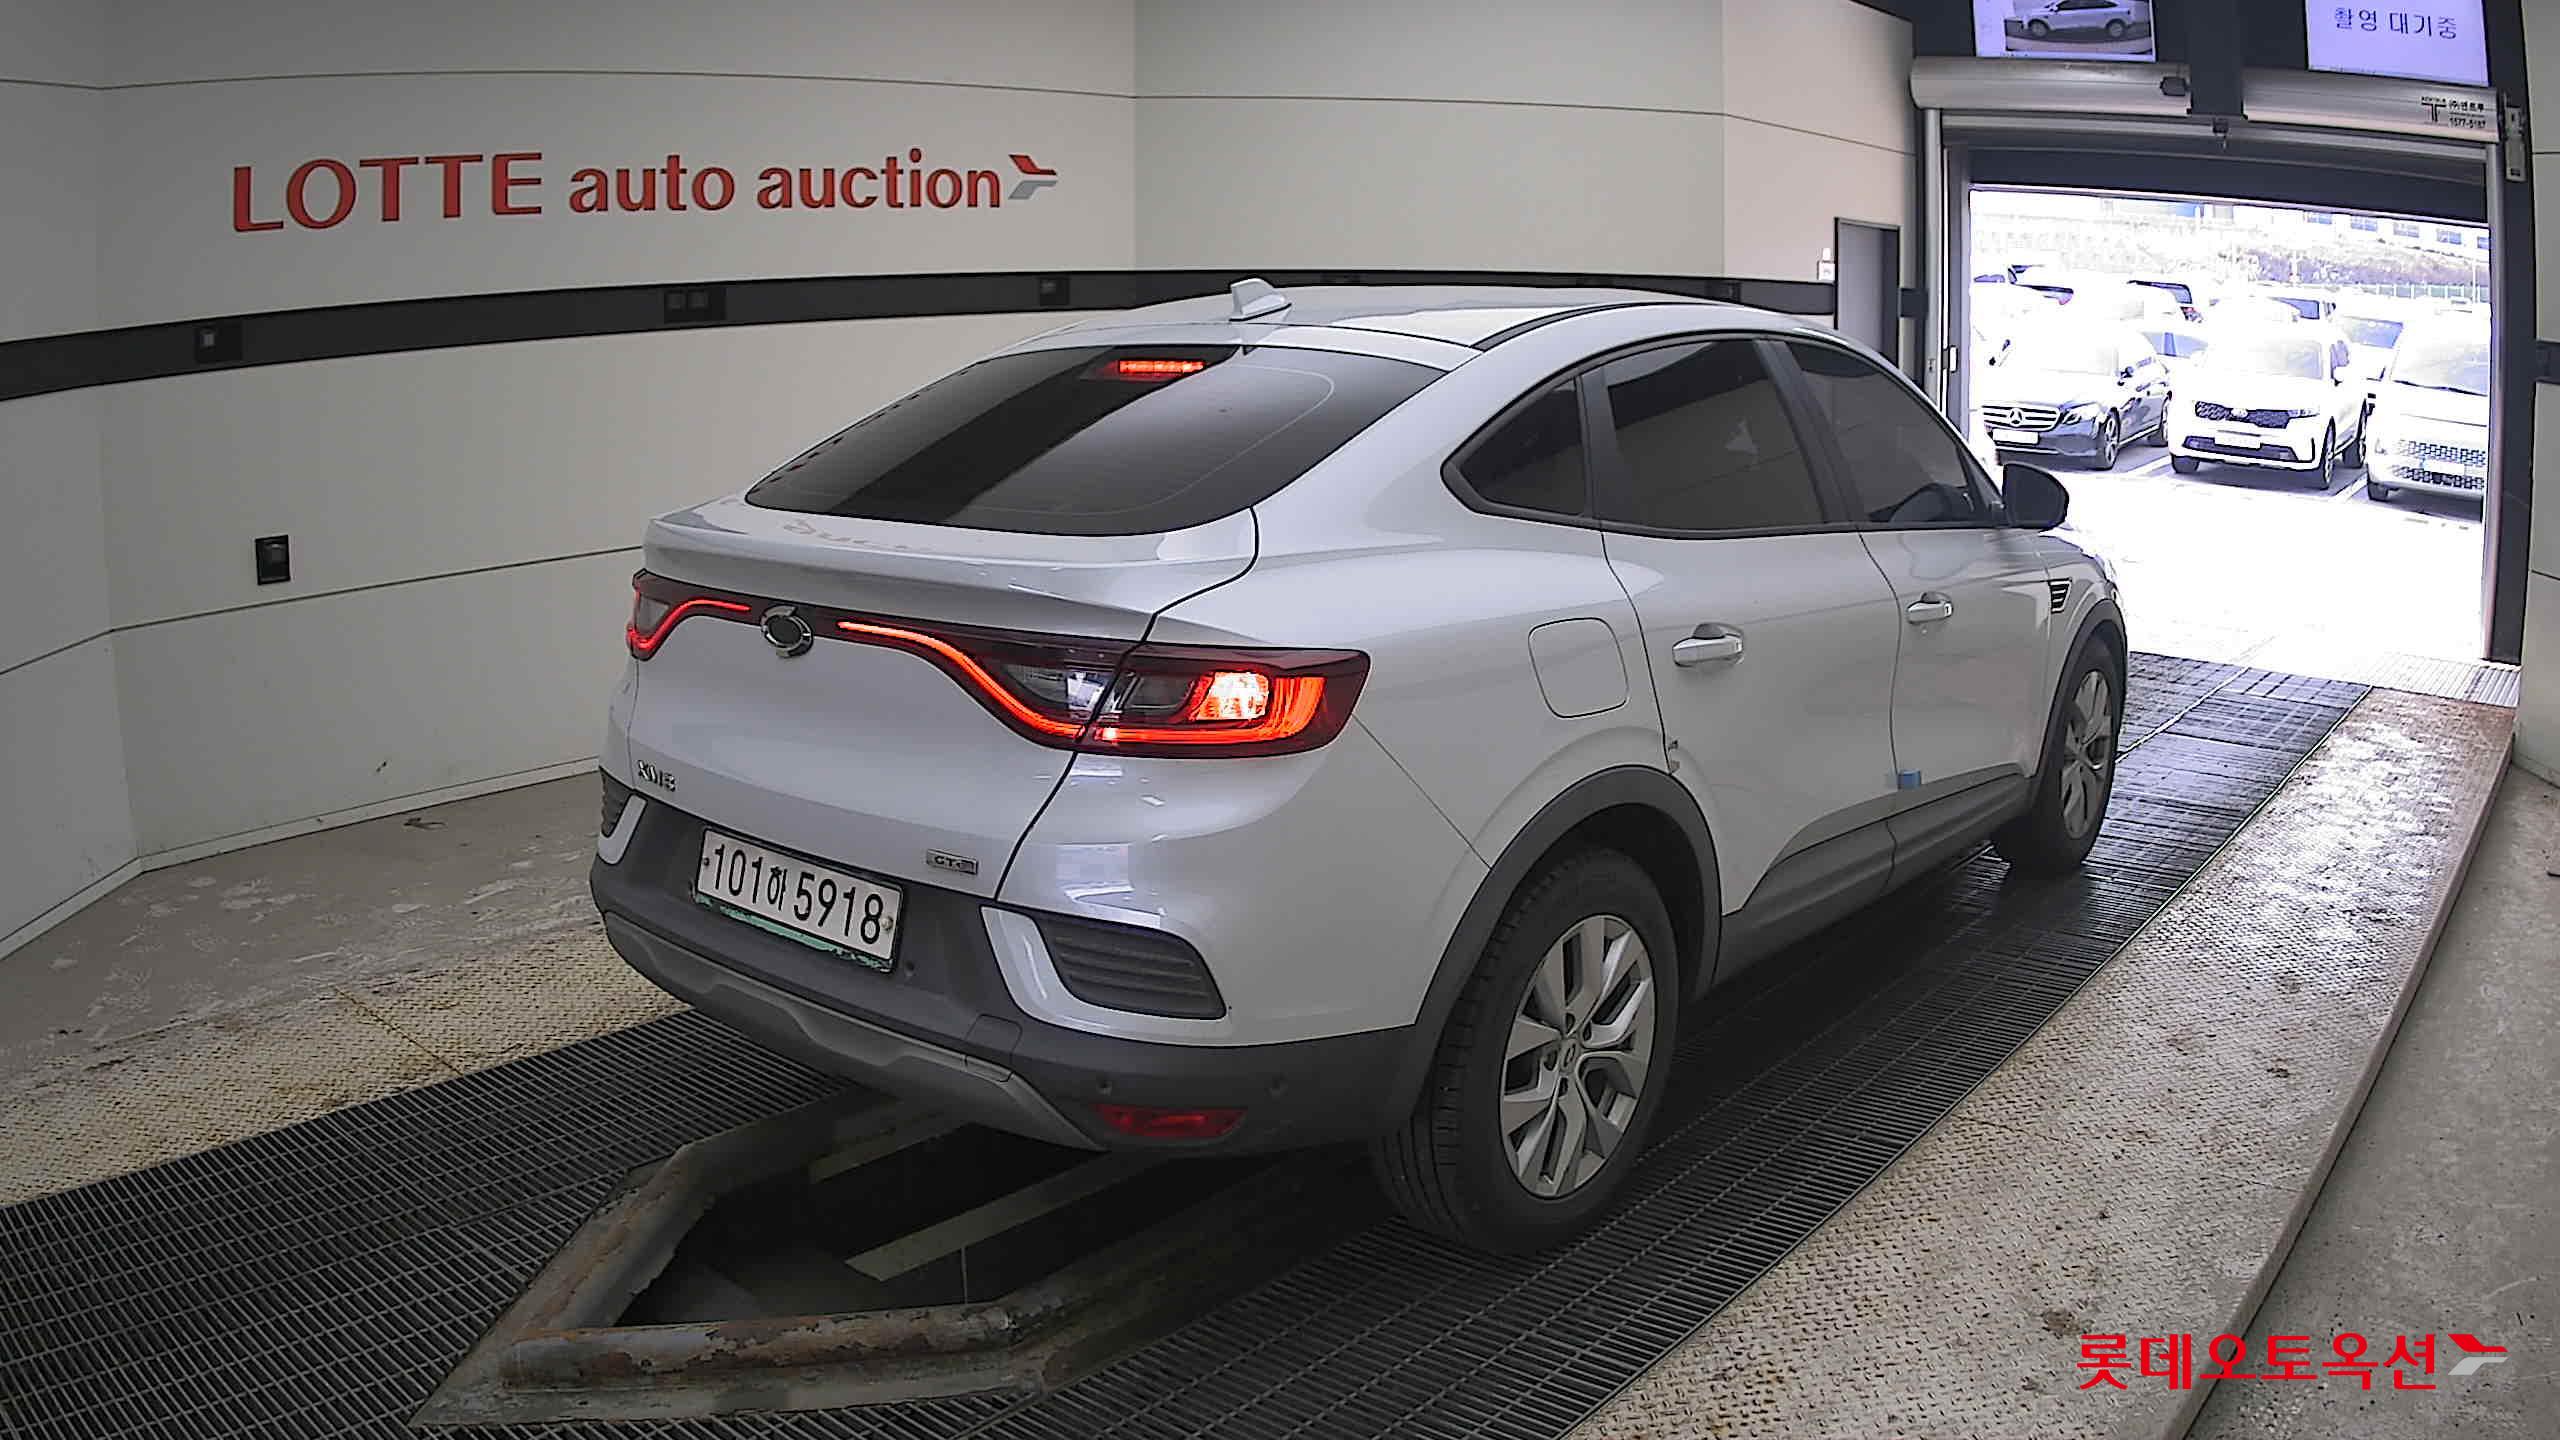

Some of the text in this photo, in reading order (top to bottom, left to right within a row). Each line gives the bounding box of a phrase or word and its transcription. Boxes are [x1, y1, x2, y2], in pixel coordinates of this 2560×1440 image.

[2334, 7, 2457, 40] 촬영 대기중
[233, 149, 1002, 231] LOTTE auto auction
